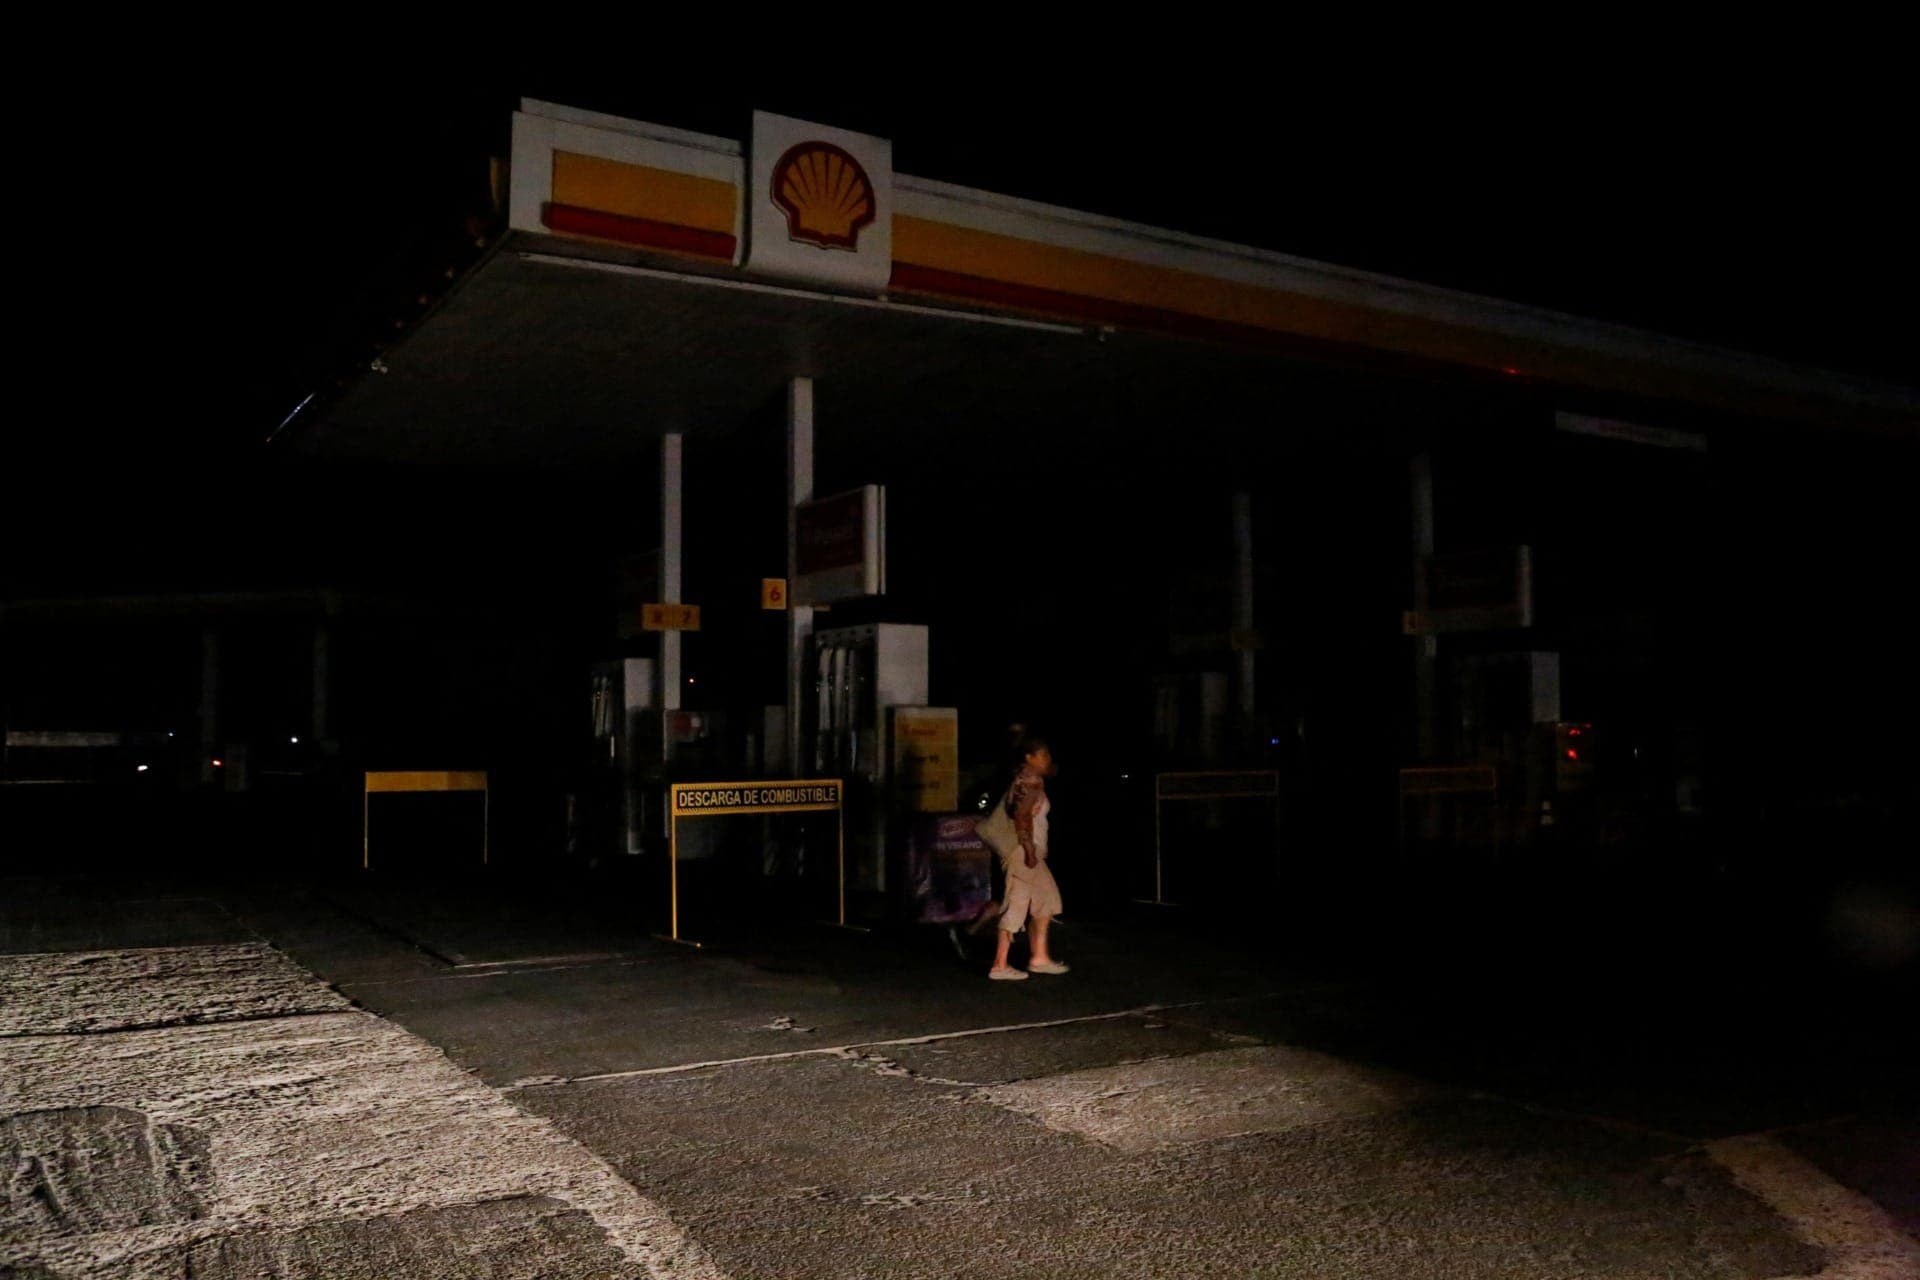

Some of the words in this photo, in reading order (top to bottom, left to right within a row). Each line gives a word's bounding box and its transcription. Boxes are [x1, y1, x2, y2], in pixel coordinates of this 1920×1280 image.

[770, 586, 781, 601] 6
[678, 790, 742, 807] DESCARGA
[743, 790, 759, 805] DE
[760, 787, 837, 803] COMBUSTIBLE
